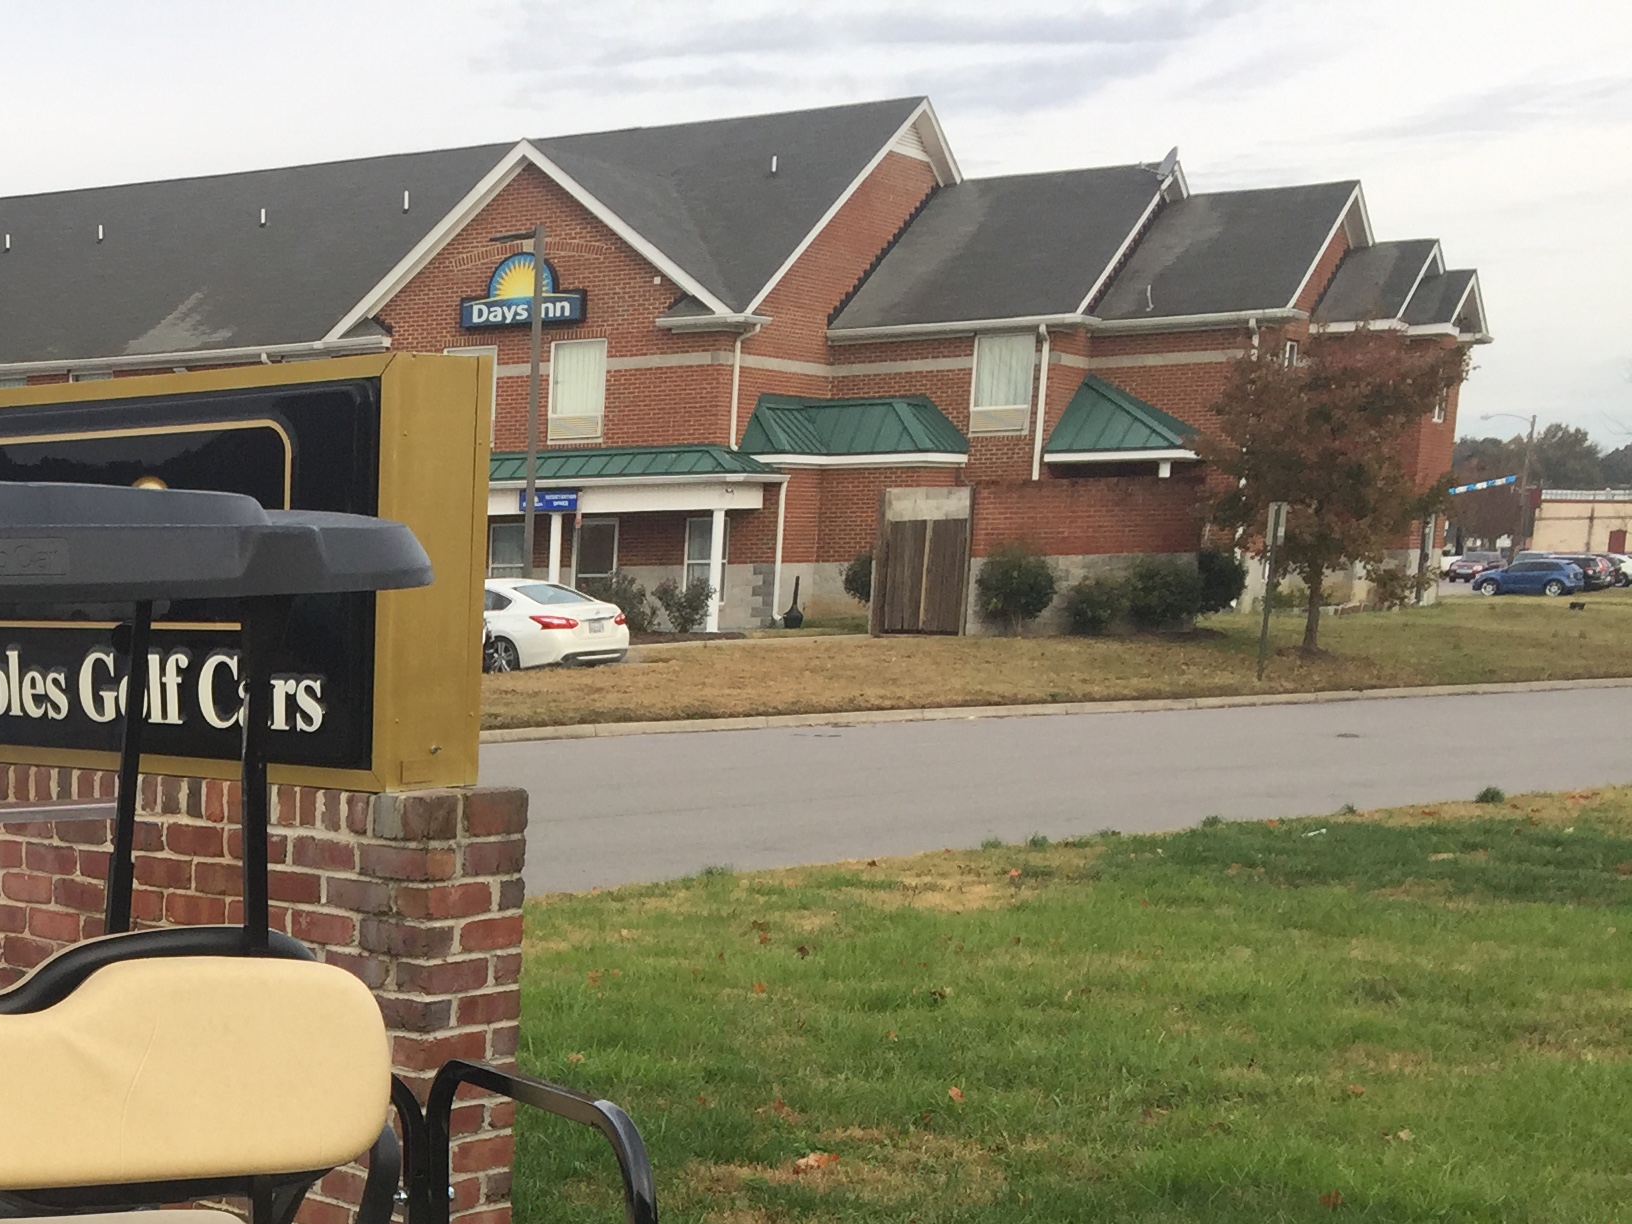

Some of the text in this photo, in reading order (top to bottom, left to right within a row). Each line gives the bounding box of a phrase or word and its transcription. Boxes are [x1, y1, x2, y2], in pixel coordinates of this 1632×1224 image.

[472, 301, 570, 323] Days nn
[198, 654, 324, 732] Crs
